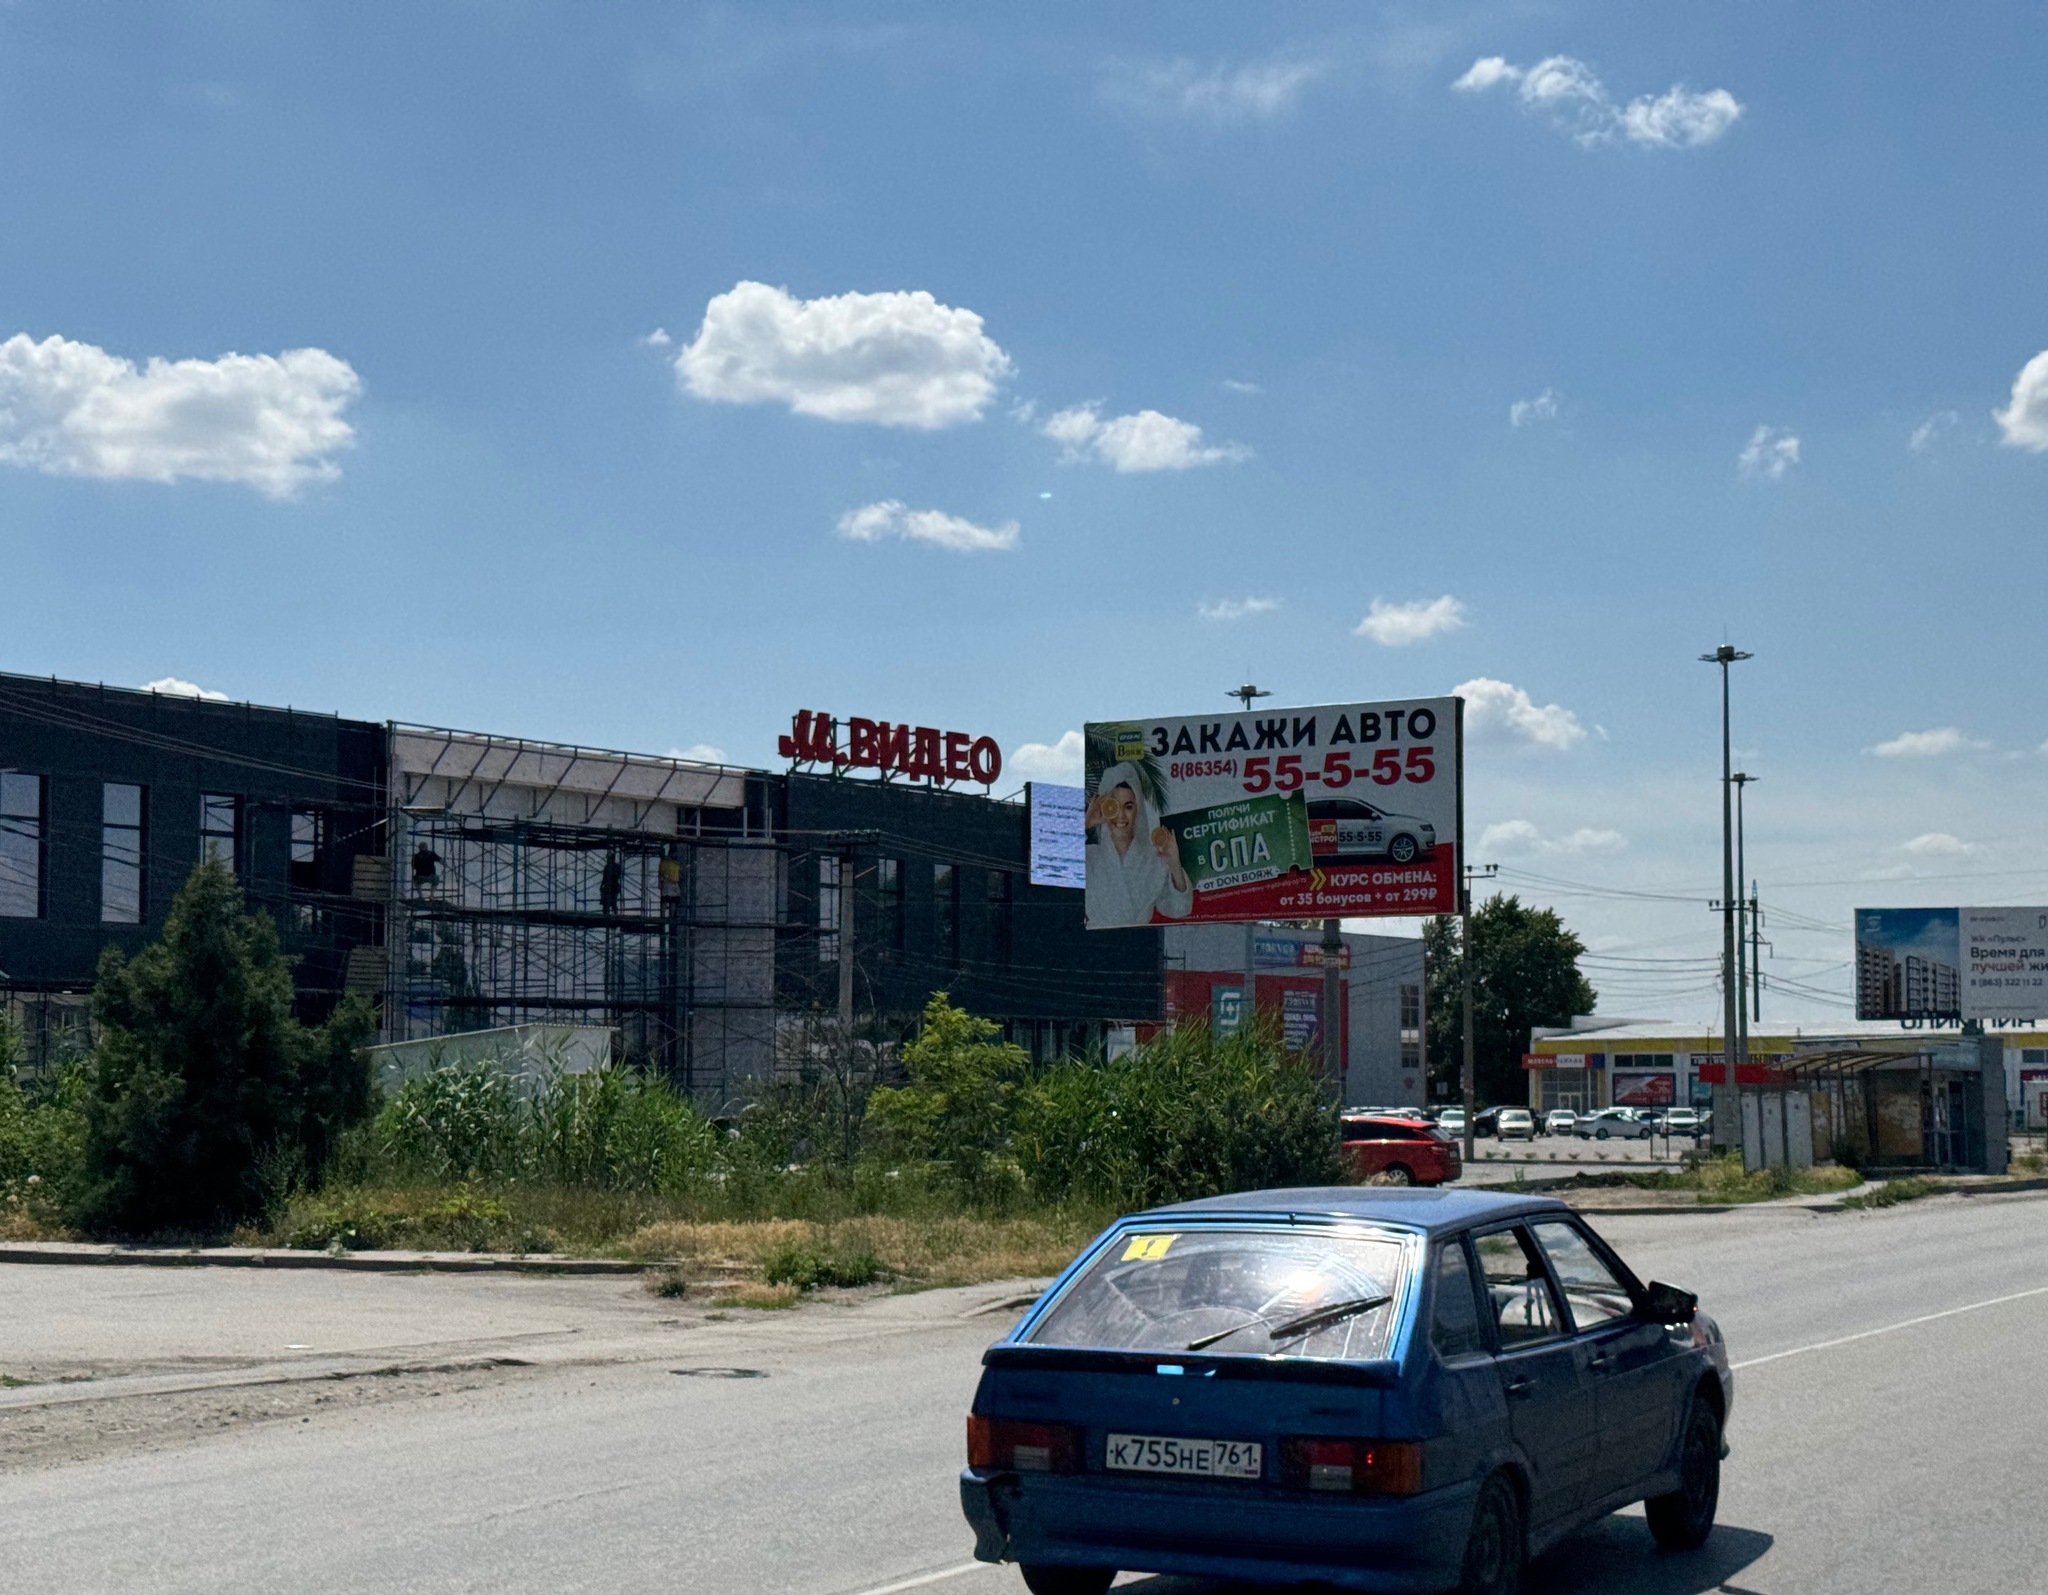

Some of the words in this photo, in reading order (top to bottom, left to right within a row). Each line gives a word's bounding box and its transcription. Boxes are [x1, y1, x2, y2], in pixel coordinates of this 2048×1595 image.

[1151, 716, 1316, 757] ЗАКАЖИ
[1329, 708, 1436, 745] АВТО
[1170, 758, 1237, 781] 8(86354)
[1242, 746, 1436, 793] 55-5-55
[1208, 803, 1250, 820] ПОЛУЧИ
[1183, 810, 1275, 839] СЕРТИФИКАТ
[1210, 832, 1271, 872] СПА
[1217, 874, 1239, 886] DON
[1242, 868, 1273, 882] ВОЯЖ
[1330, 873, 1369, 886] КУРС
[1372, 871, 1437, 885] ОБМЕНА:
[1280, 897, 1294, 906] от
[1297, 893, 1313, 905] 35
[1316, 892, 1372, 907] бонусов
[1385, 893, 1400, 902] от
[1970, 946, 2016, 960] Время
[2020, 948, 2045, 960] для
[1972, 959, 2025, 974] лучшей
[1114, 1439, 1209, 1471] К755НЕ
[1216, 1443, 1253, 1467] 761
